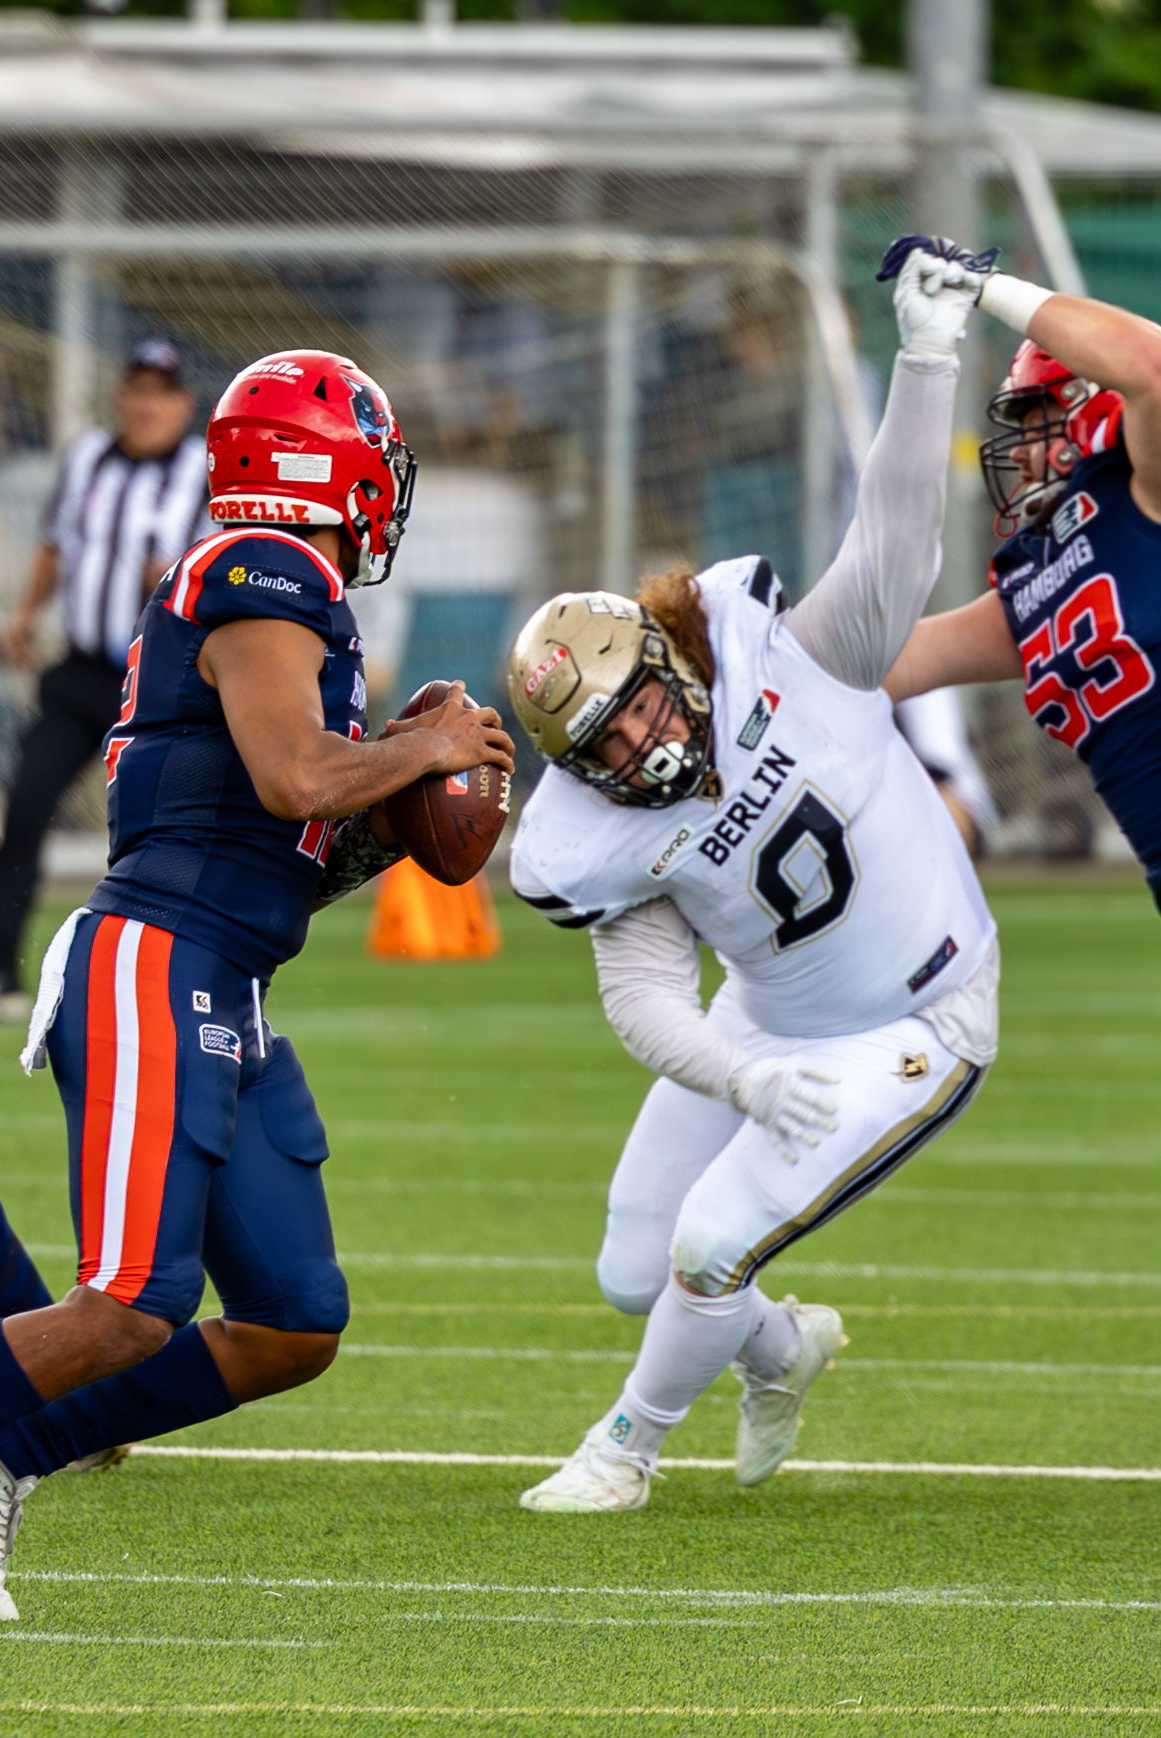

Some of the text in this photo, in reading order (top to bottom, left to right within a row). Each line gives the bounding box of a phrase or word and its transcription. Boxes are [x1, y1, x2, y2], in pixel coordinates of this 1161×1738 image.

[246, 361, 304, 376] mile
[209, 501, 310, 523] FORELLE
[248, 571, 302, 594] CanDoc
[1013, 534, 1094, 623] HAMBURG
[526, 648, 565, 694] GAZI
[1019, 572, 1156, 751] 53
[698, 744, 797, 867] BERLIN
[749, 779, 862, 956] 0
